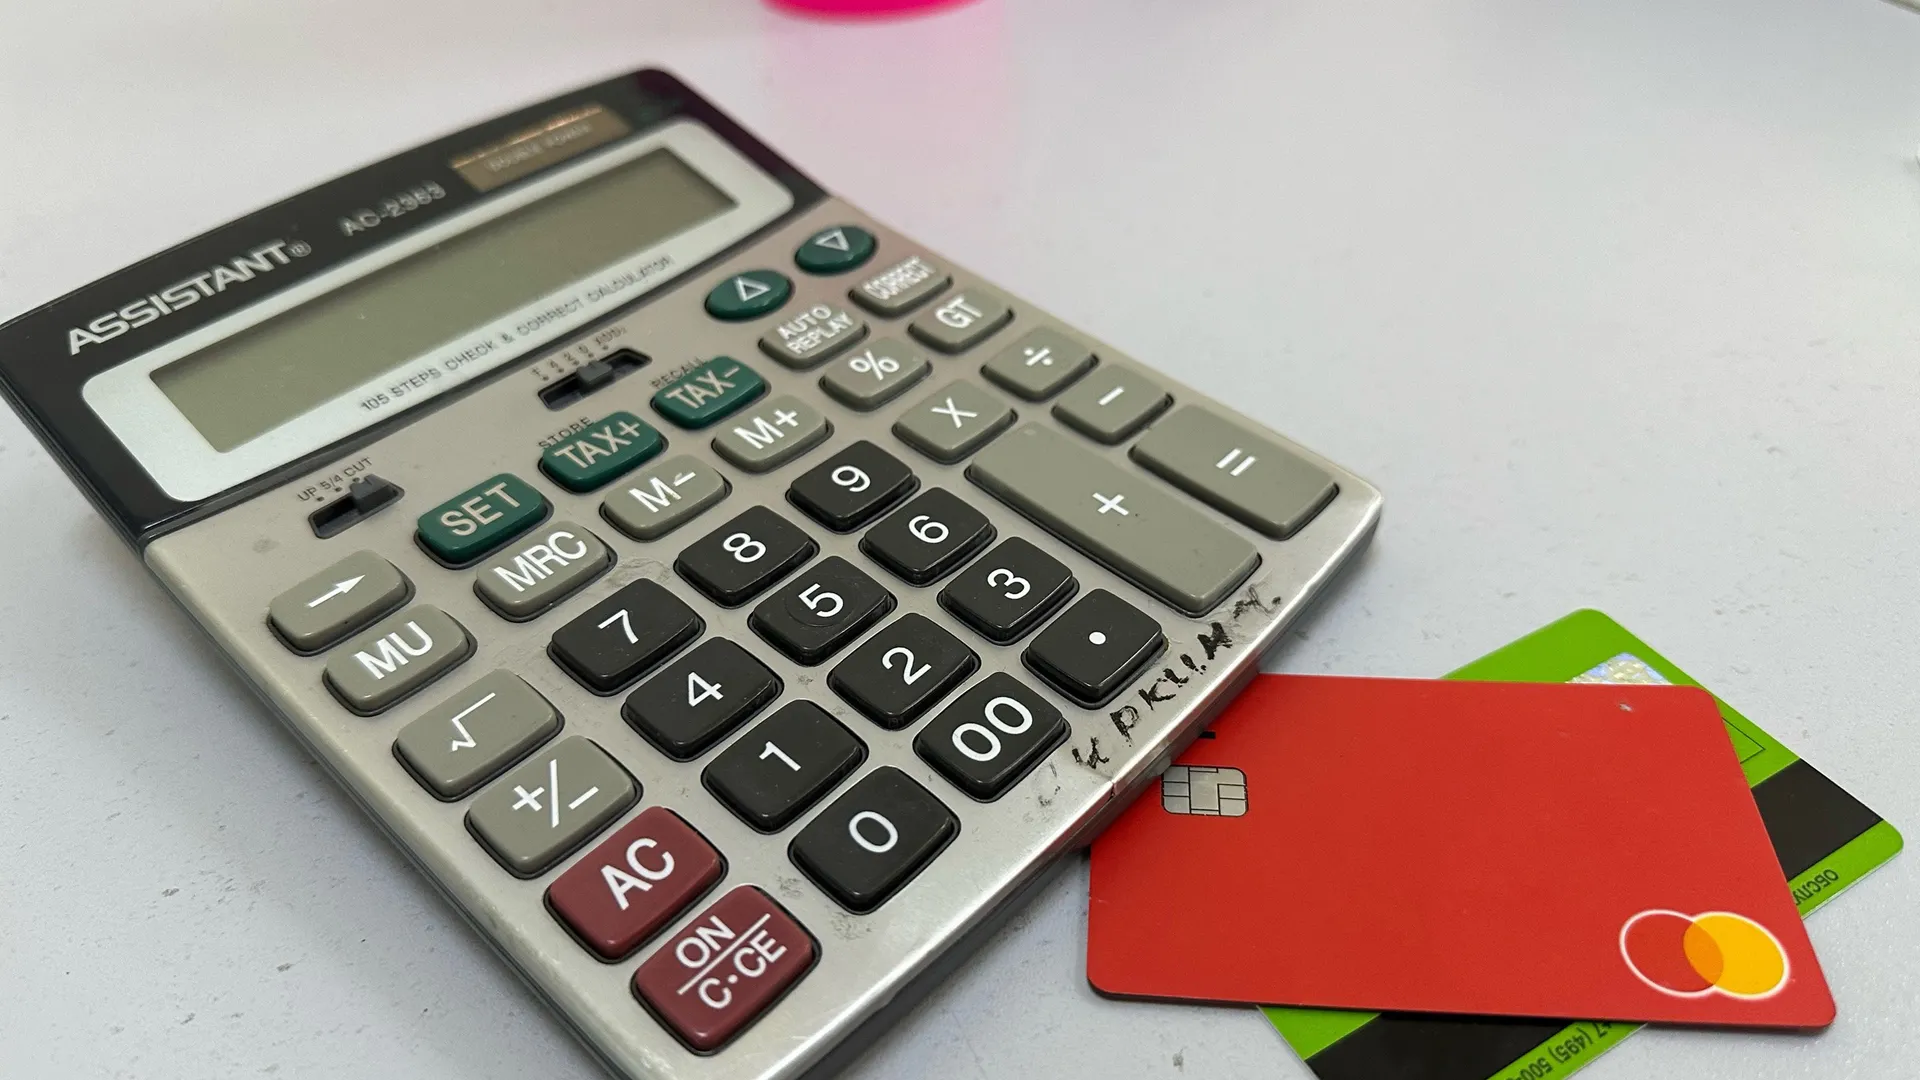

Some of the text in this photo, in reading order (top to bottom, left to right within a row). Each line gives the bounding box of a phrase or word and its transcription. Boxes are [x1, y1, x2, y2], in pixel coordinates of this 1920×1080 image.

[862, 255, 937, 300] CORRECT
[777, 304, 832, 340] AUTO
[786, 311, 854, 354] REPLAY
[935, 296, 983, 329] GT
[359, 254, 676, 412] 105 STEPS CHECK & CORRECT CALCULATOR
[538, 416, 597, 450] STORE
[553, 420, 641, 470] TAX+
[732, 408, 799, 450] M+
[297, 456, 374, 502] UP 5/4 CUT
[831, 464, 872, 493] 9
[439, 480, 524, 538] SET
[722, 531, 767, 564] 8
[907, 514, 950, 545] 6
[493, 530, 588, 592] MRC
[798, 583, 844, 618] 5
[986, 567, 1032, 601] 3
[597, 609, 642, 645] 7
[352, 620, 434, 681] MU
[881, 646, 933, 686] 2
[687, 670, 725, 707] 4
[951, 696, 1034, 763] 00
[758, 740, 802, 773] 1
[848, 810, 900, 854] 0
[599, 836, 676, 911] AC
[675, 914, 737, 970] ON
[1548, 1027, 1594, 1064] (495)
[1505, 1057, 1554, 1080] 500-
